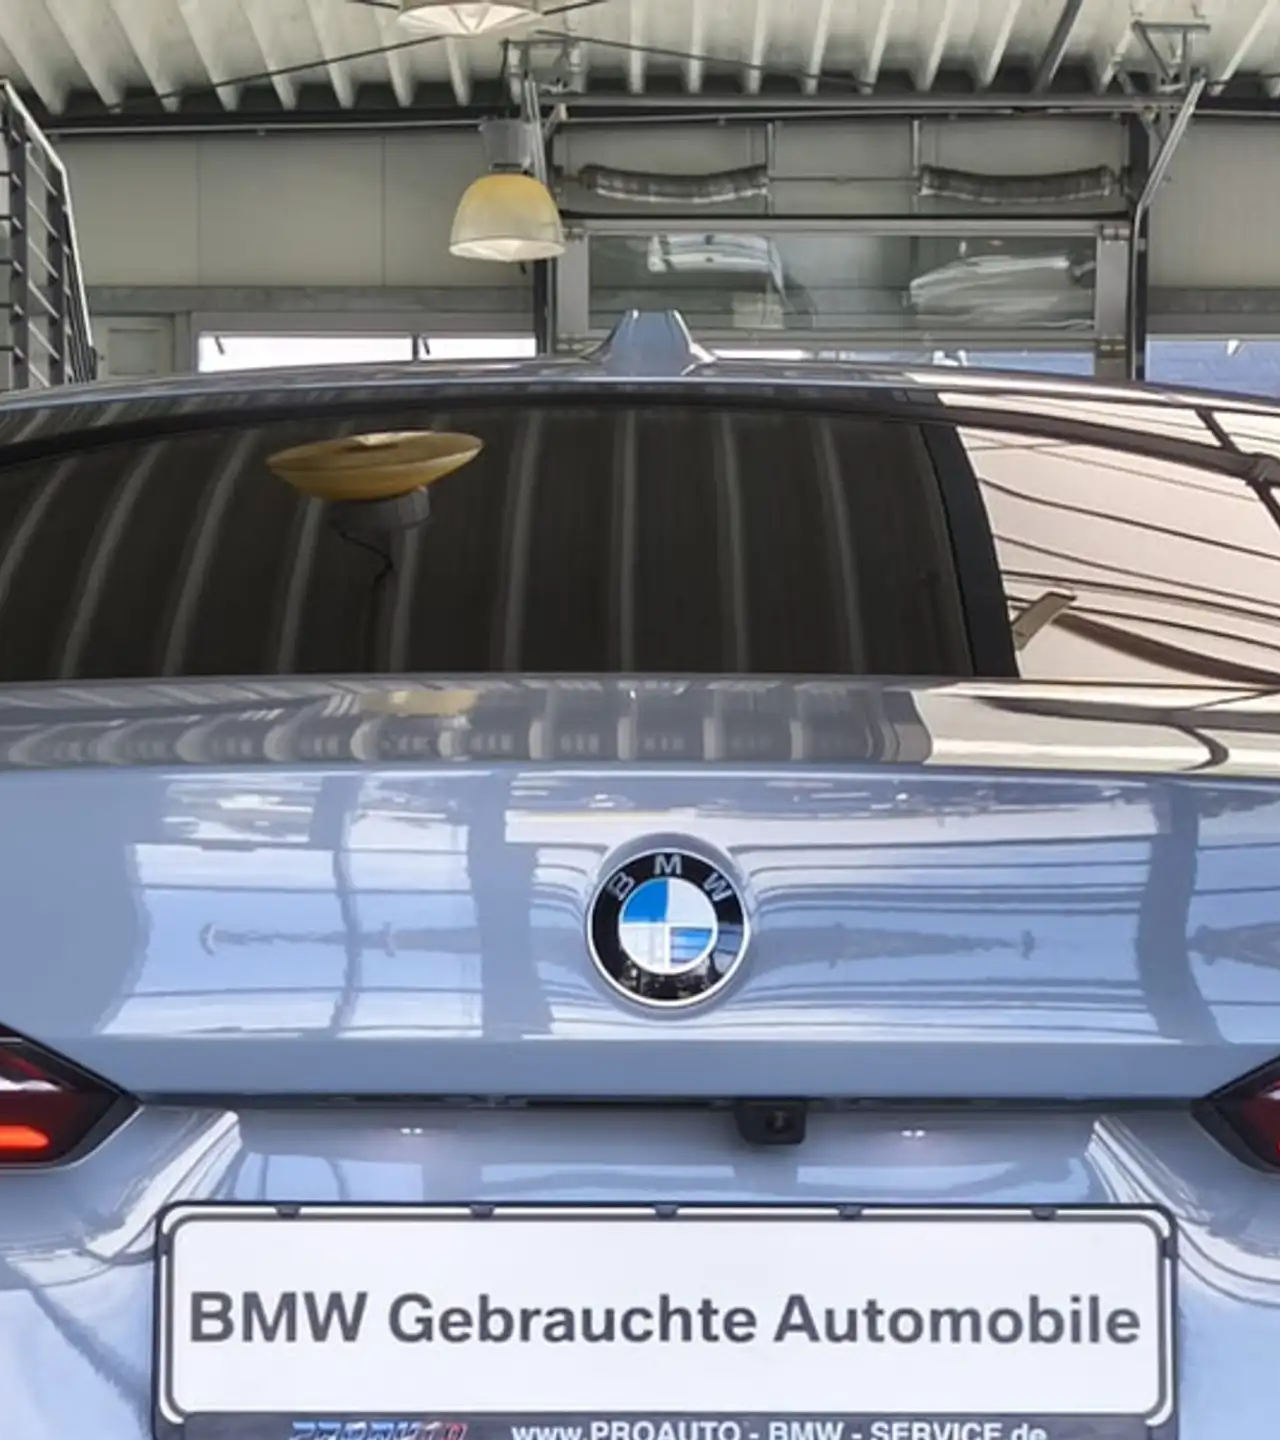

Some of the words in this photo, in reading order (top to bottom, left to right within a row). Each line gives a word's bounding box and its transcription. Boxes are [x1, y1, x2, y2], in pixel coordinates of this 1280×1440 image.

[606, 854, 733, 902] BMW
[190, 1291, 368, 1343] BMW
[389, 1293, 757, 1343] Gebrauchte
[773, 1294, 1140, 1344] Automobile
